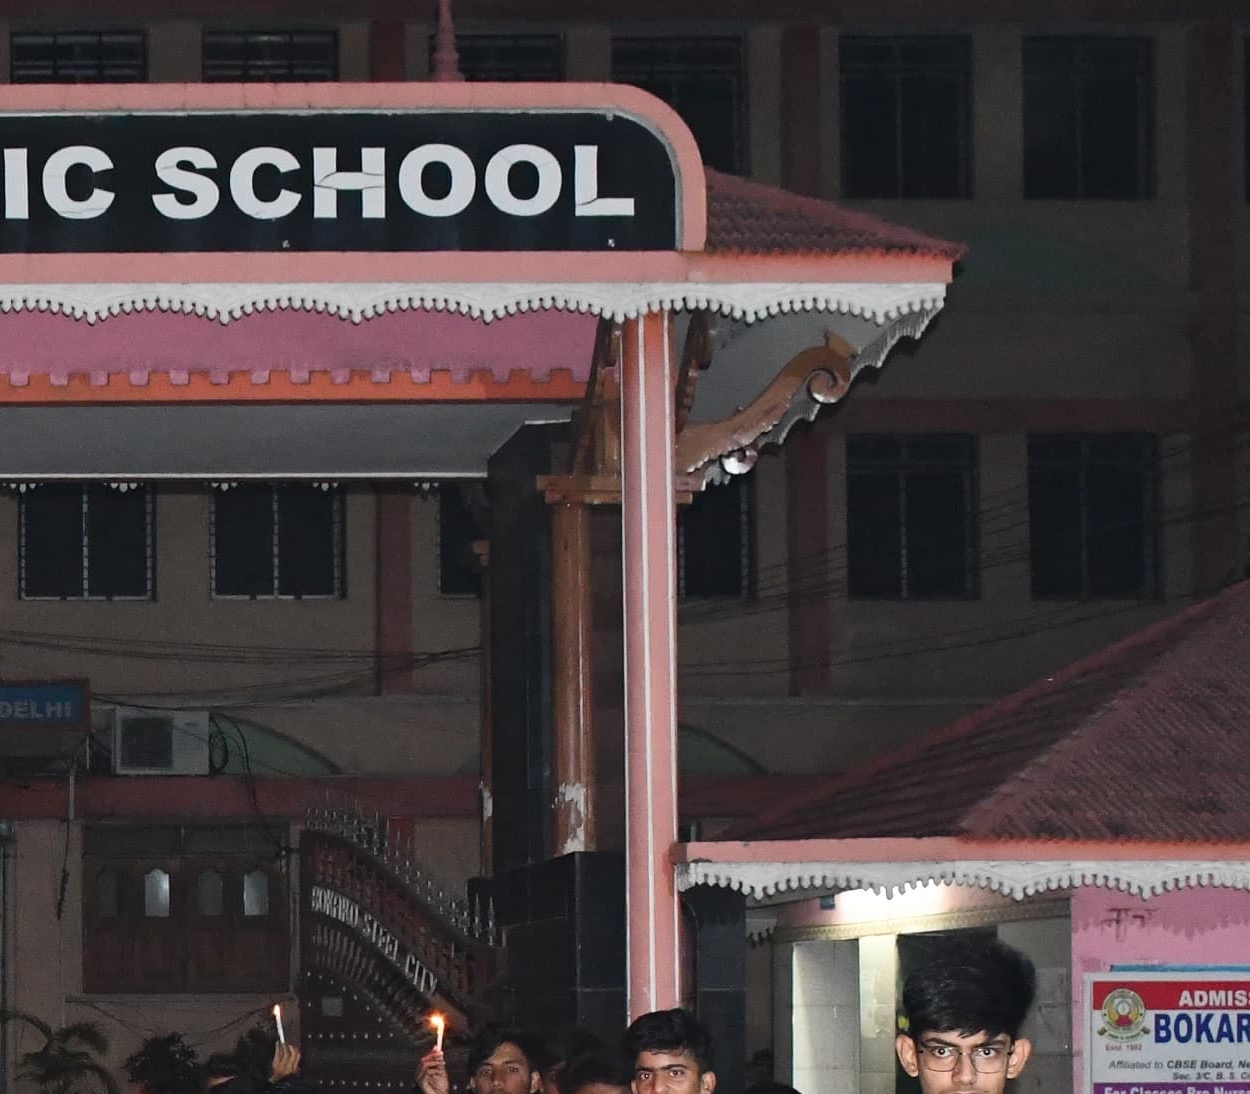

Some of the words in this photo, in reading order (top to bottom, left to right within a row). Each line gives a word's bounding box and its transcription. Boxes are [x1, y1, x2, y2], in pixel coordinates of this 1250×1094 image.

[152, 143, 635, 220] SCHOOL
[1179, 989, 1250, 1007] ADMIS
[1108, 1060, 1151, 1069] Affiliated
[1166, 1060, 1197, 1069] CBSE
[1200, 1060, 1234, 1070] Board,
